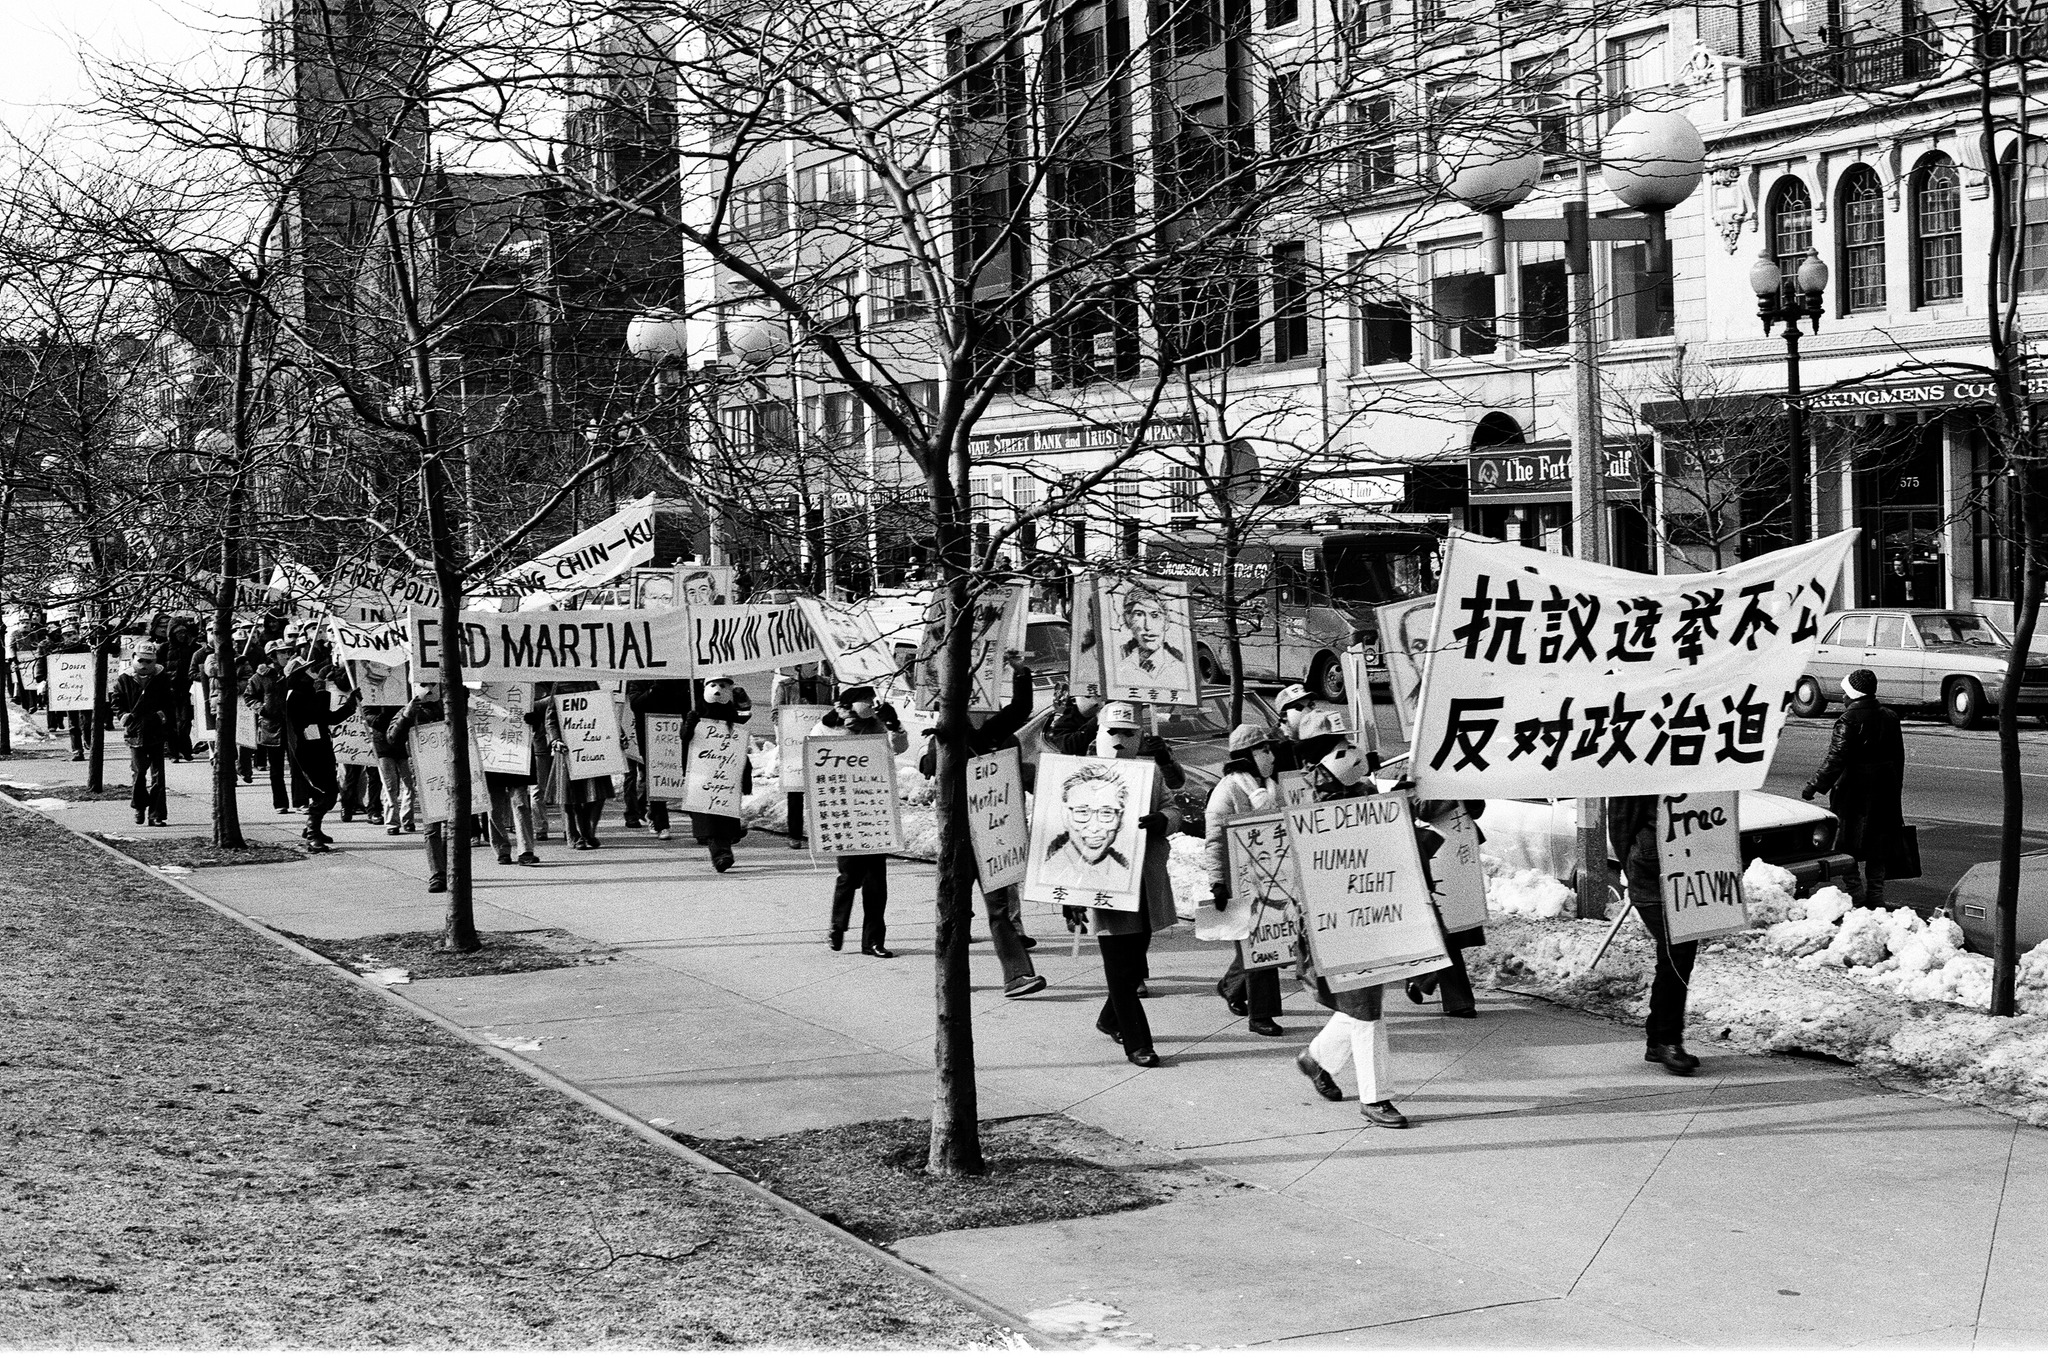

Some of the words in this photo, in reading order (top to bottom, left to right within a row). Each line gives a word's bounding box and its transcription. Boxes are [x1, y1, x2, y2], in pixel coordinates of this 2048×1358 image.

[994, 434, 1030, 454] STREET
[1033, 430, 1063, 451] BANK
[1065, 437, 1081, 448] and
[1085, 426, 1118, 447] TRUST
[1502, 455, 1534, 483] The
[1539, 454, 1573, 481] Fatt
[1604, 450, 1632, 478] alf
[1900, 477, 1920, 488] 575
[501, 621, 667, 669] MARTIAL
[696, 618, 741, 665] LAW
[741, 615, 761, 661] IN
[562, 697, 588, 712] END
[563, 717, 597, 730] Martial
[655, 721, 679, 732] STO
[706, 725, 739, 741] People
[1430, 683, 1795, 773] 反对政治迫
[815, 748, 869, 767] Free
[975, 762, 998, 780] END
[1292, 808, 1331, 835] WE
[1334, 801, 1400, 830] DEMAND
[1663, 793, 1728, 844] Free
[986, 843, 1027, 877] TAIWAN
[1313, 848, 1369, 870] HUMAN
[1347, 870, 1397, 894] RIGHT
[1667, 870, 1743, 912] TAIWAN
[1317, 912, 1338, 932] IN
[1347, 903, 1403, 927] TAIWAN
